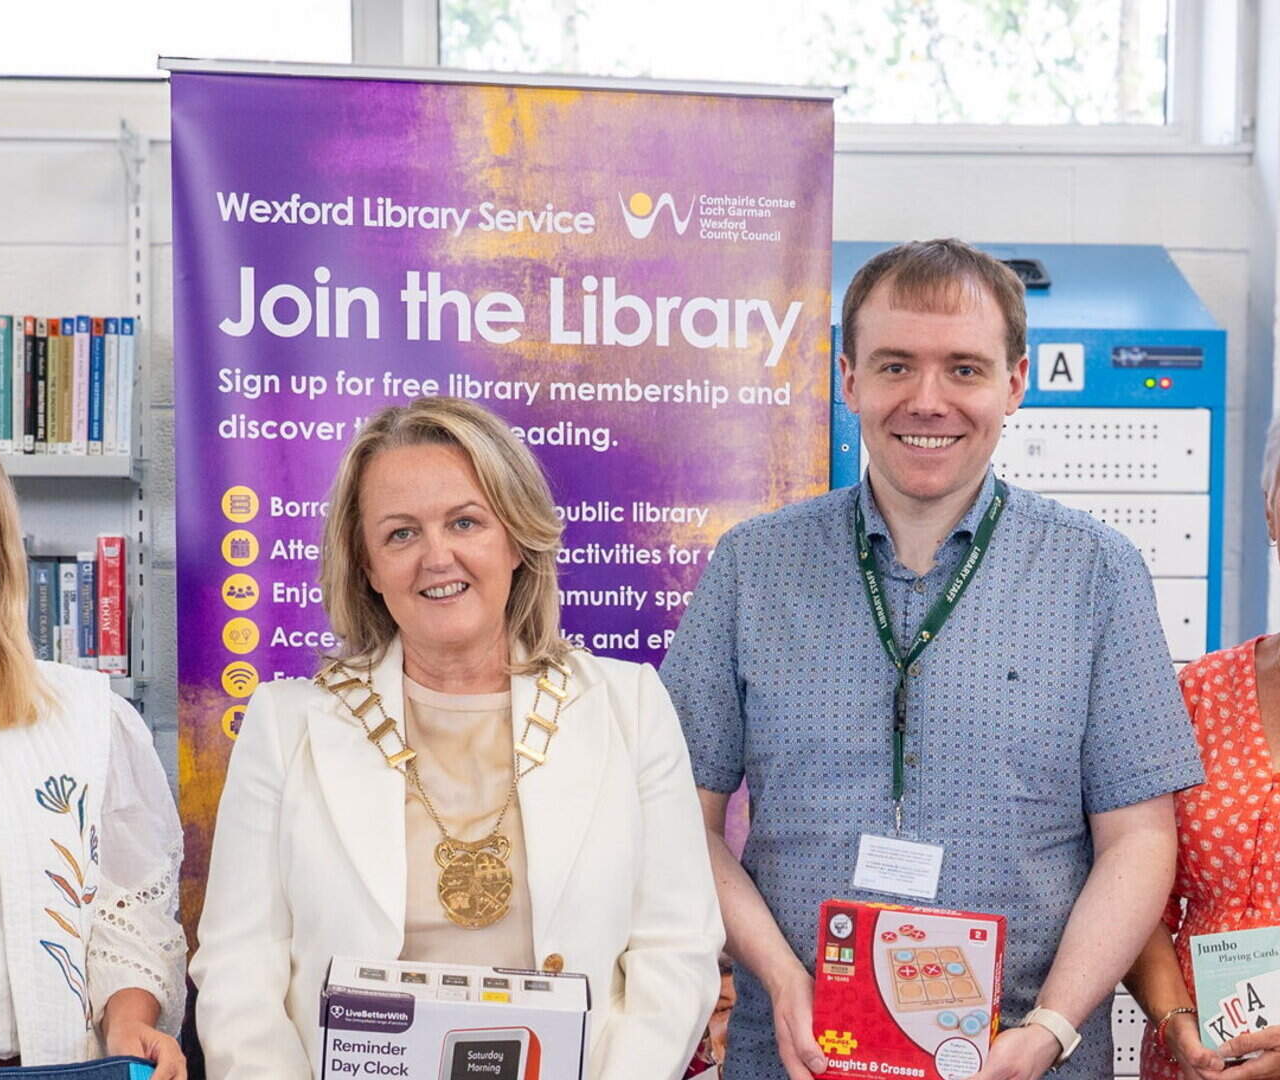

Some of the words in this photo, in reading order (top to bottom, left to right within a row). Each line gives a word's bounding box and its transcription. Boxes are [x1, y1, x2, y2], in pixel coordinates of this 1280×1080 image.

[700, 194, 755, 208] Comhairle
[758, 197, 796, 209] Contae
[700, 204, 725, 216] Loch
[728, 206, 771, 218] Garman
[217, 192, 354, 227] Wexford
[364, 199, 470, 237] Library
[479, 203, 595, 235] Service
[700, 218, 746, 230] Wexford
[700, 229, 738, 242] County
[741, 231, 781, 242] Council
[218, 266, 380, 339] Join
[401, 270, 525, 344] the
[549, 276, 804, 367] Library
[1049, 351, 1073, 383] A
[218, 368, 280, 401] Sign
[291, 375, 327, 402] up
[336, 372, 374, 397] for
[383, 374, 439, 399] free
[449, 374, 540, 407] library
[549, 379, 729, 409] membership
[738, 382, 791, 407] and
[218, 414, 345, 442] discover
[509, 424, 618, 451] eading.
[632, 502, 708, 527] library
[556, 543, 662, 564] activities
[668, 544, 700, 564] for
[956, 547, 981, 582] LIBRARY
[865, 569, 878, 595] STAFF
[945, 578, 965, 604] STAFF
[273, 582, 323, 608] Enjo
[871, 593, 887, 630] LIBRARY
[592, 629, 639, 649] and
[1197, 940, 1238, 955] Jumbo
[1218, 952, 1251, 963] Playing
[1253, 948, 1279, 959] Cards
[1246, 982, 1265, 1012] A
[346, 1009, 409, 1021] LiveBetterWith
[1209, 1016, 1234, 1042] K
[333, 1038, 407, 1056] Reminder
[467, 1050, 504, 1063] Saturday
[332, 1059, 360, 1077] Day
[364, 1061, 409, 1076] Clock
[467, 1062, 502, 1076] Morning
[870, 1060, 879, 1073] &
[881, 1063, 925, 1078] Crosses
